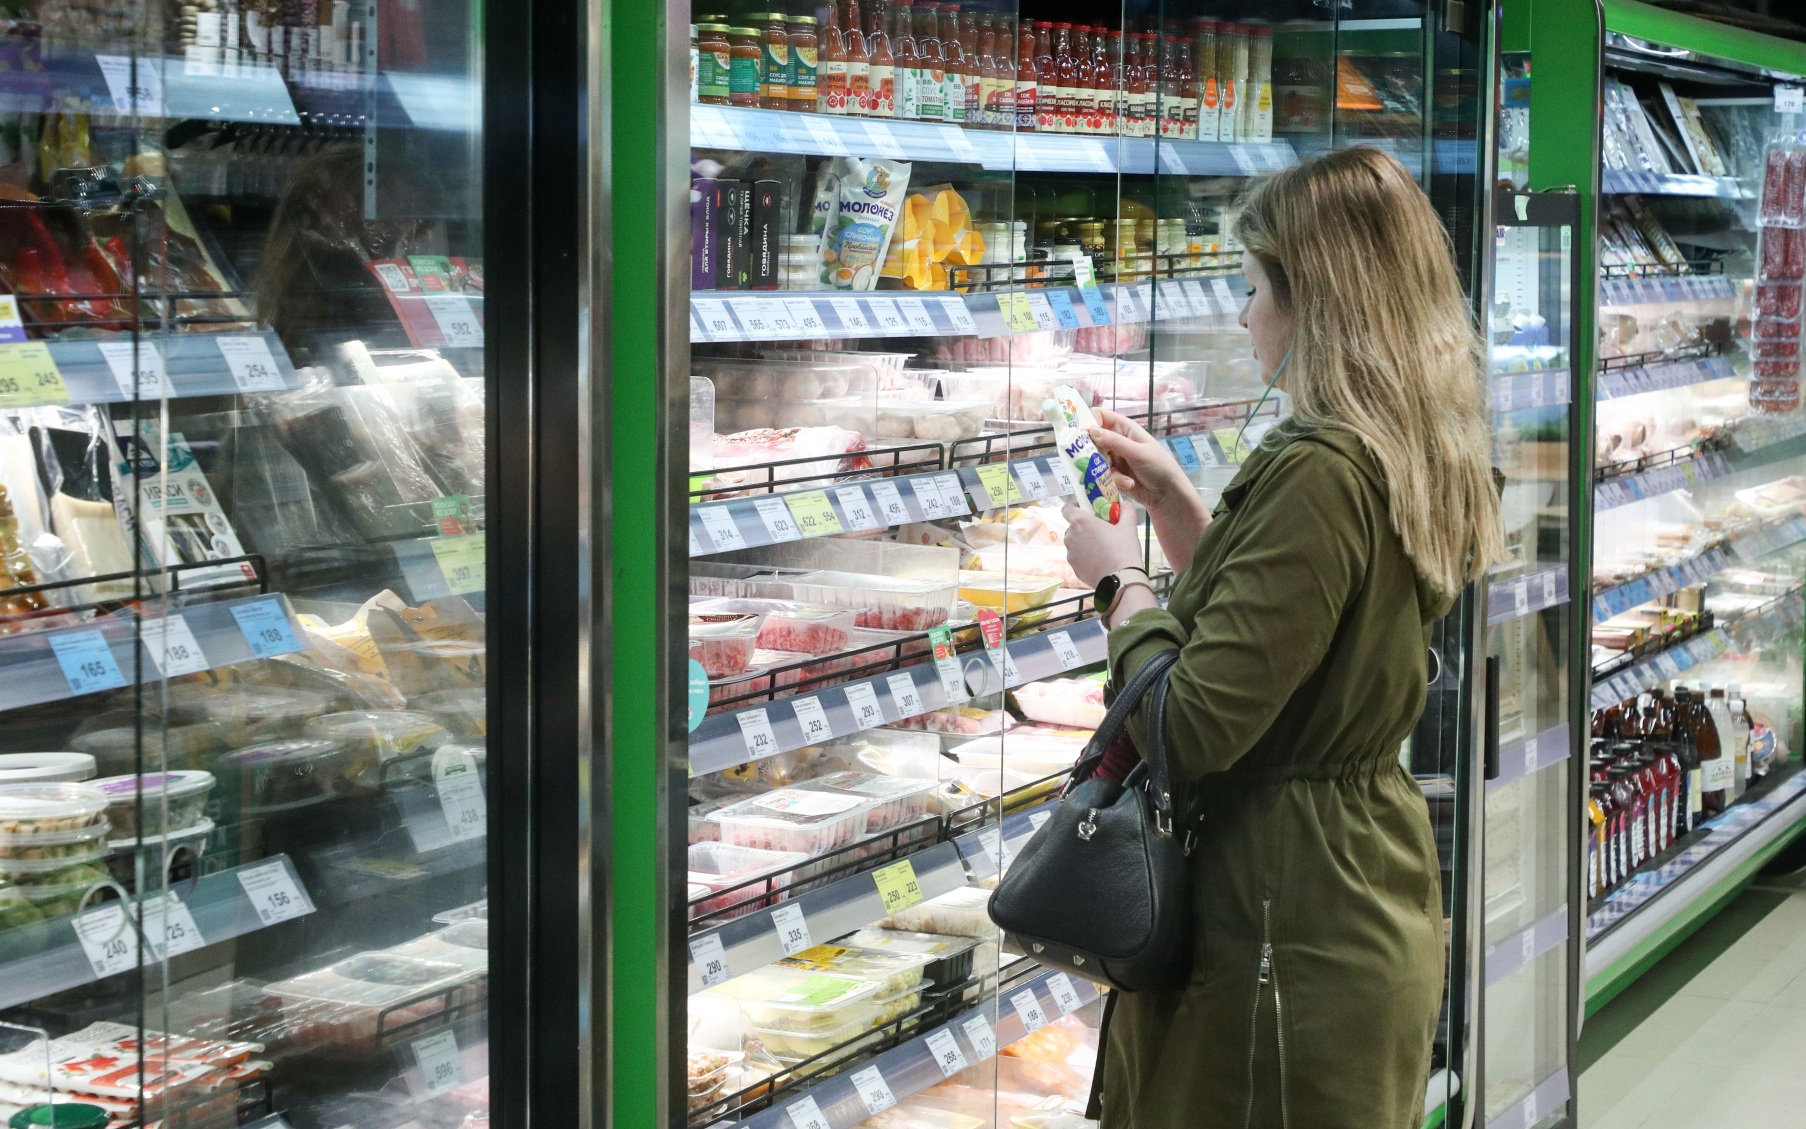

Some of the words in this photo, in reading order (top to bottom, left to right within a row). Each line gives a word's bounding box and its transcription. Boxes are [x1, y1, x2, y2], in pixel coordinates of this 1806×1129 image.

[840, 201, 895, 222] МОЛОНЕЗ
[858, 226, 874, 235] СОУС
[803, 317, 818, 328] 495
[885, 316, 899, 327] 125
[914, 316, 928, 327] 115
[1040, 312, 1051, 322] 115
[451, 322, 472, 335] 582
[713, 320, 728, 331] 607
[749, 319, 765, 330] 565
[774, 319, 791, 330] 573
[245, 364, 269, 378] 254
[34, 371, 59, 386] 245
[926, 499, 940, 510] 242
[802, 515, 818, 527] 622
[822, 511, 836, 522] 554
[852, 509, 867, 520] 312
[773, 520, 789, 531] 623
[718, 529, 734, 541] 314
[452, 566, 471, 581] 397
[260, 628, 284, 643] 188
[165, 645, 190, 662] 188
[80, 661, 106, 679] 165
[901, 694, 914, 707] 307
[861, 705, 875, 718] 293
[808, 719, 823, 733] 252
[753, 733, 769, 747] 232
[461, 808, 479, 824] 438
[906, 880, 918, 893] 223
[267, 891, 290, 908] 156
[888, 889, 901, 903] 250
[788, 928, 802, 943] 335
[102, 939, 128, 959] 240
[706, 959, 722, 975] 290
[1027, 1009, 1039, 1022] 188
[943, 1050, 958, 1065] 268
[435, 1061, 454, 1080] 596
